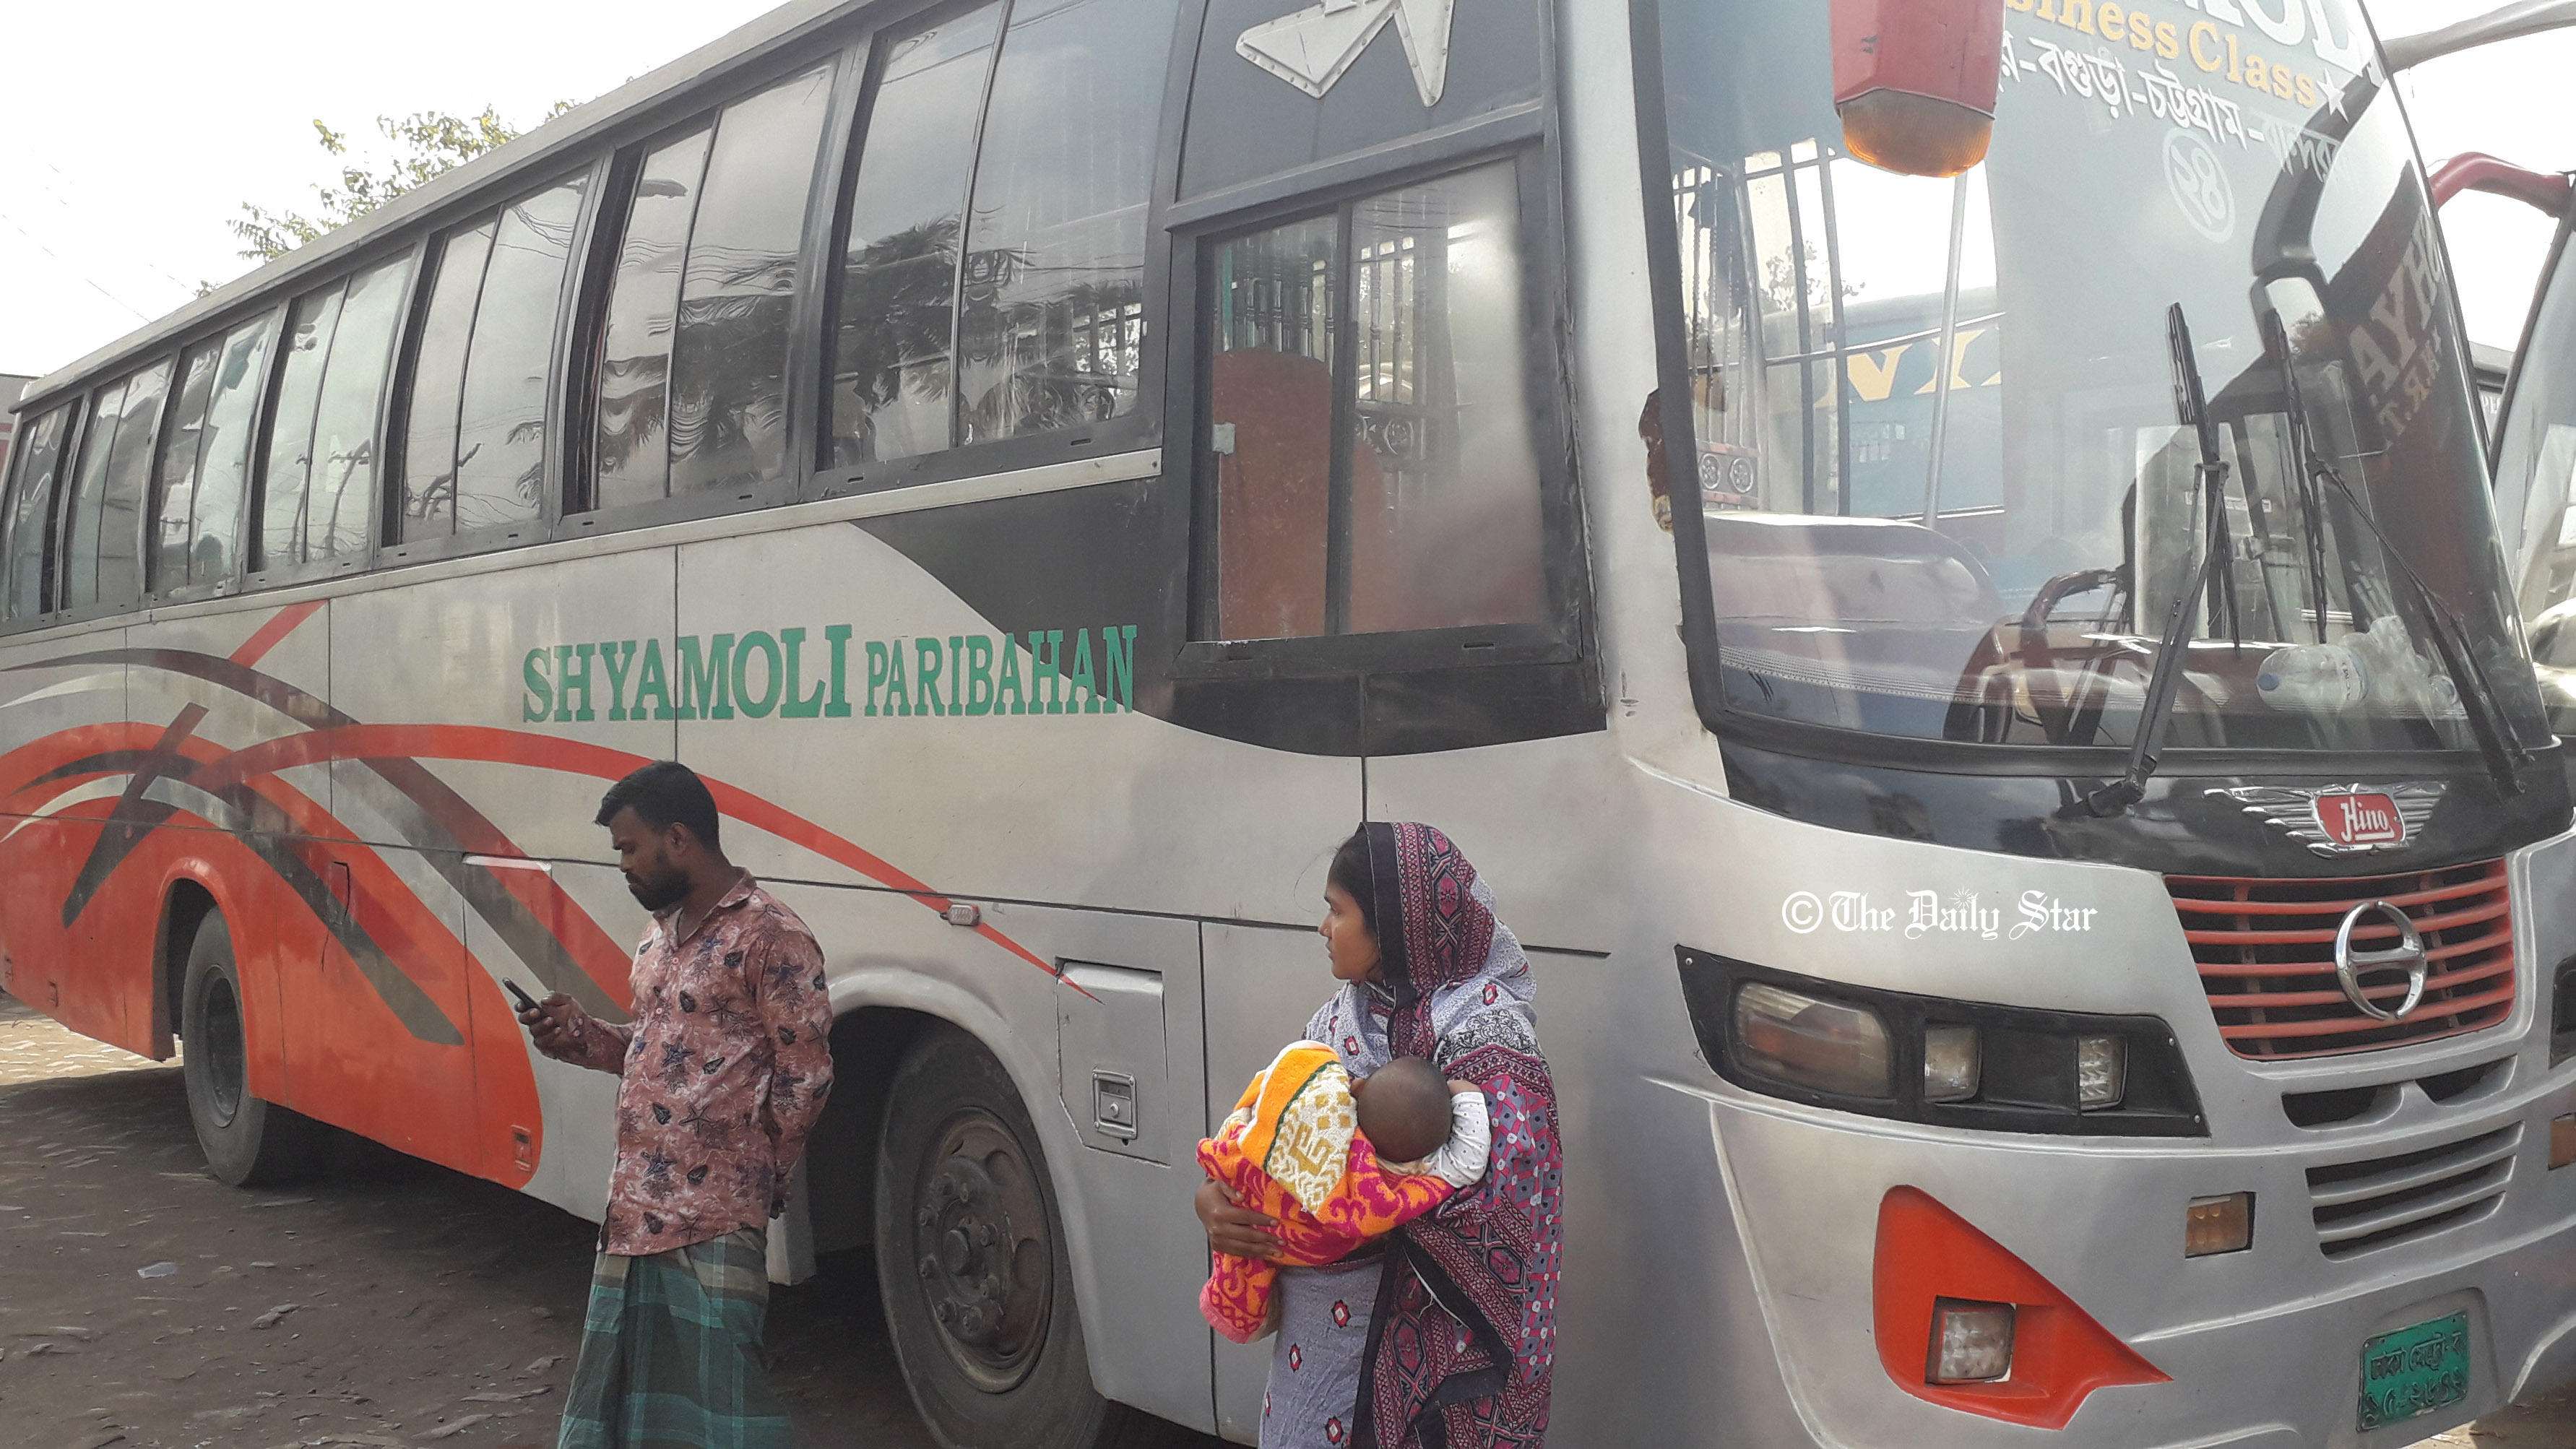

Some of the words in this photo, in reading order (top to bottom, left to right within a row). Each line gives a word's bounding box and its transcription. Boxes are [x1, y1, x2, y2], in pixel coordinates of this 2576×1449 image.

[2188, 20, 2316, 108] Class
[522, 623, 853, 722] SHYAMOLI
[865, 625, 1138, 717] PARIBAHAN
[2340, 795, 2390, 842] Hino
[2370, 1346, 2407, 1380] ঢাকা
